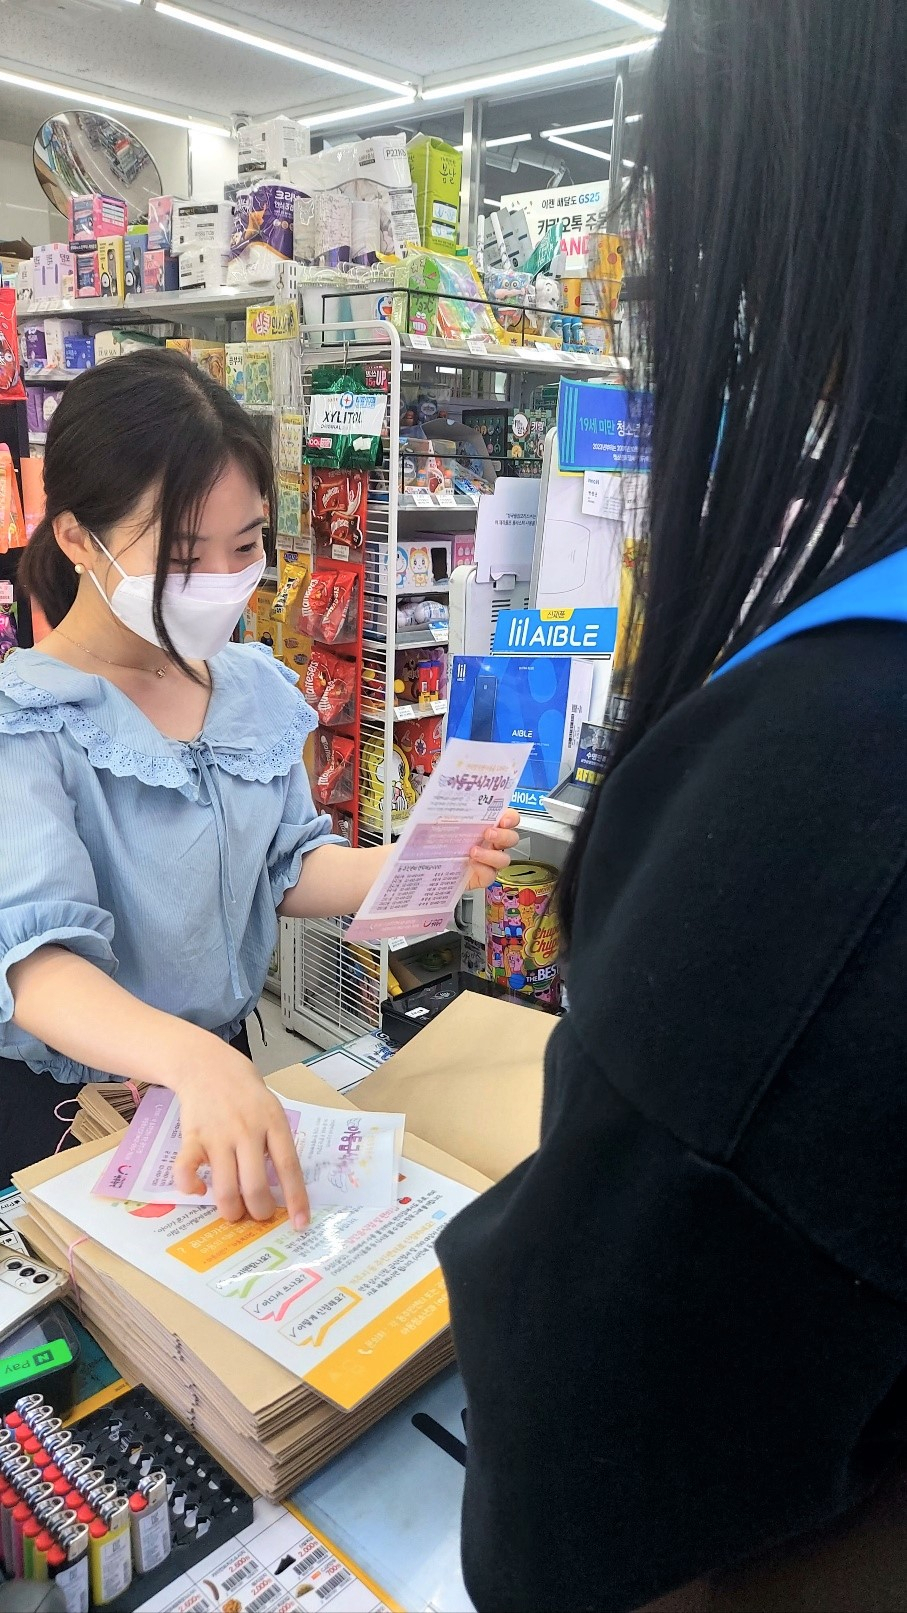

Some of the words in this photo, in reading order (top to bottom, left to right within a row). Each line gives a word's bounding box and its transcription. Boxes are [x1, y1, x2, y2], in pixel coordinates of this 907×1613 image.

[542, 198, 555, 209] 이젠
[579, 192, 600, 204] GS25
[375, 370, 387, 385] UP
[580, 417, 597, 434] 19세
[599, 419, 615, 436] 미만
[508, 617, 529, 647] lil
[528, 624, 600, 647] AIBLE
[511, 730, 533, 738] AIBLE
[262, 1290, 282, 1307] 어디서
[283, 1273, 306, 1292] 쓰나요?
[296, 1313, 317, 1331] 어떻게
[316, 1292, 345, 1316] 신청해요?
[5, 1359, 31, 1374] Pay
